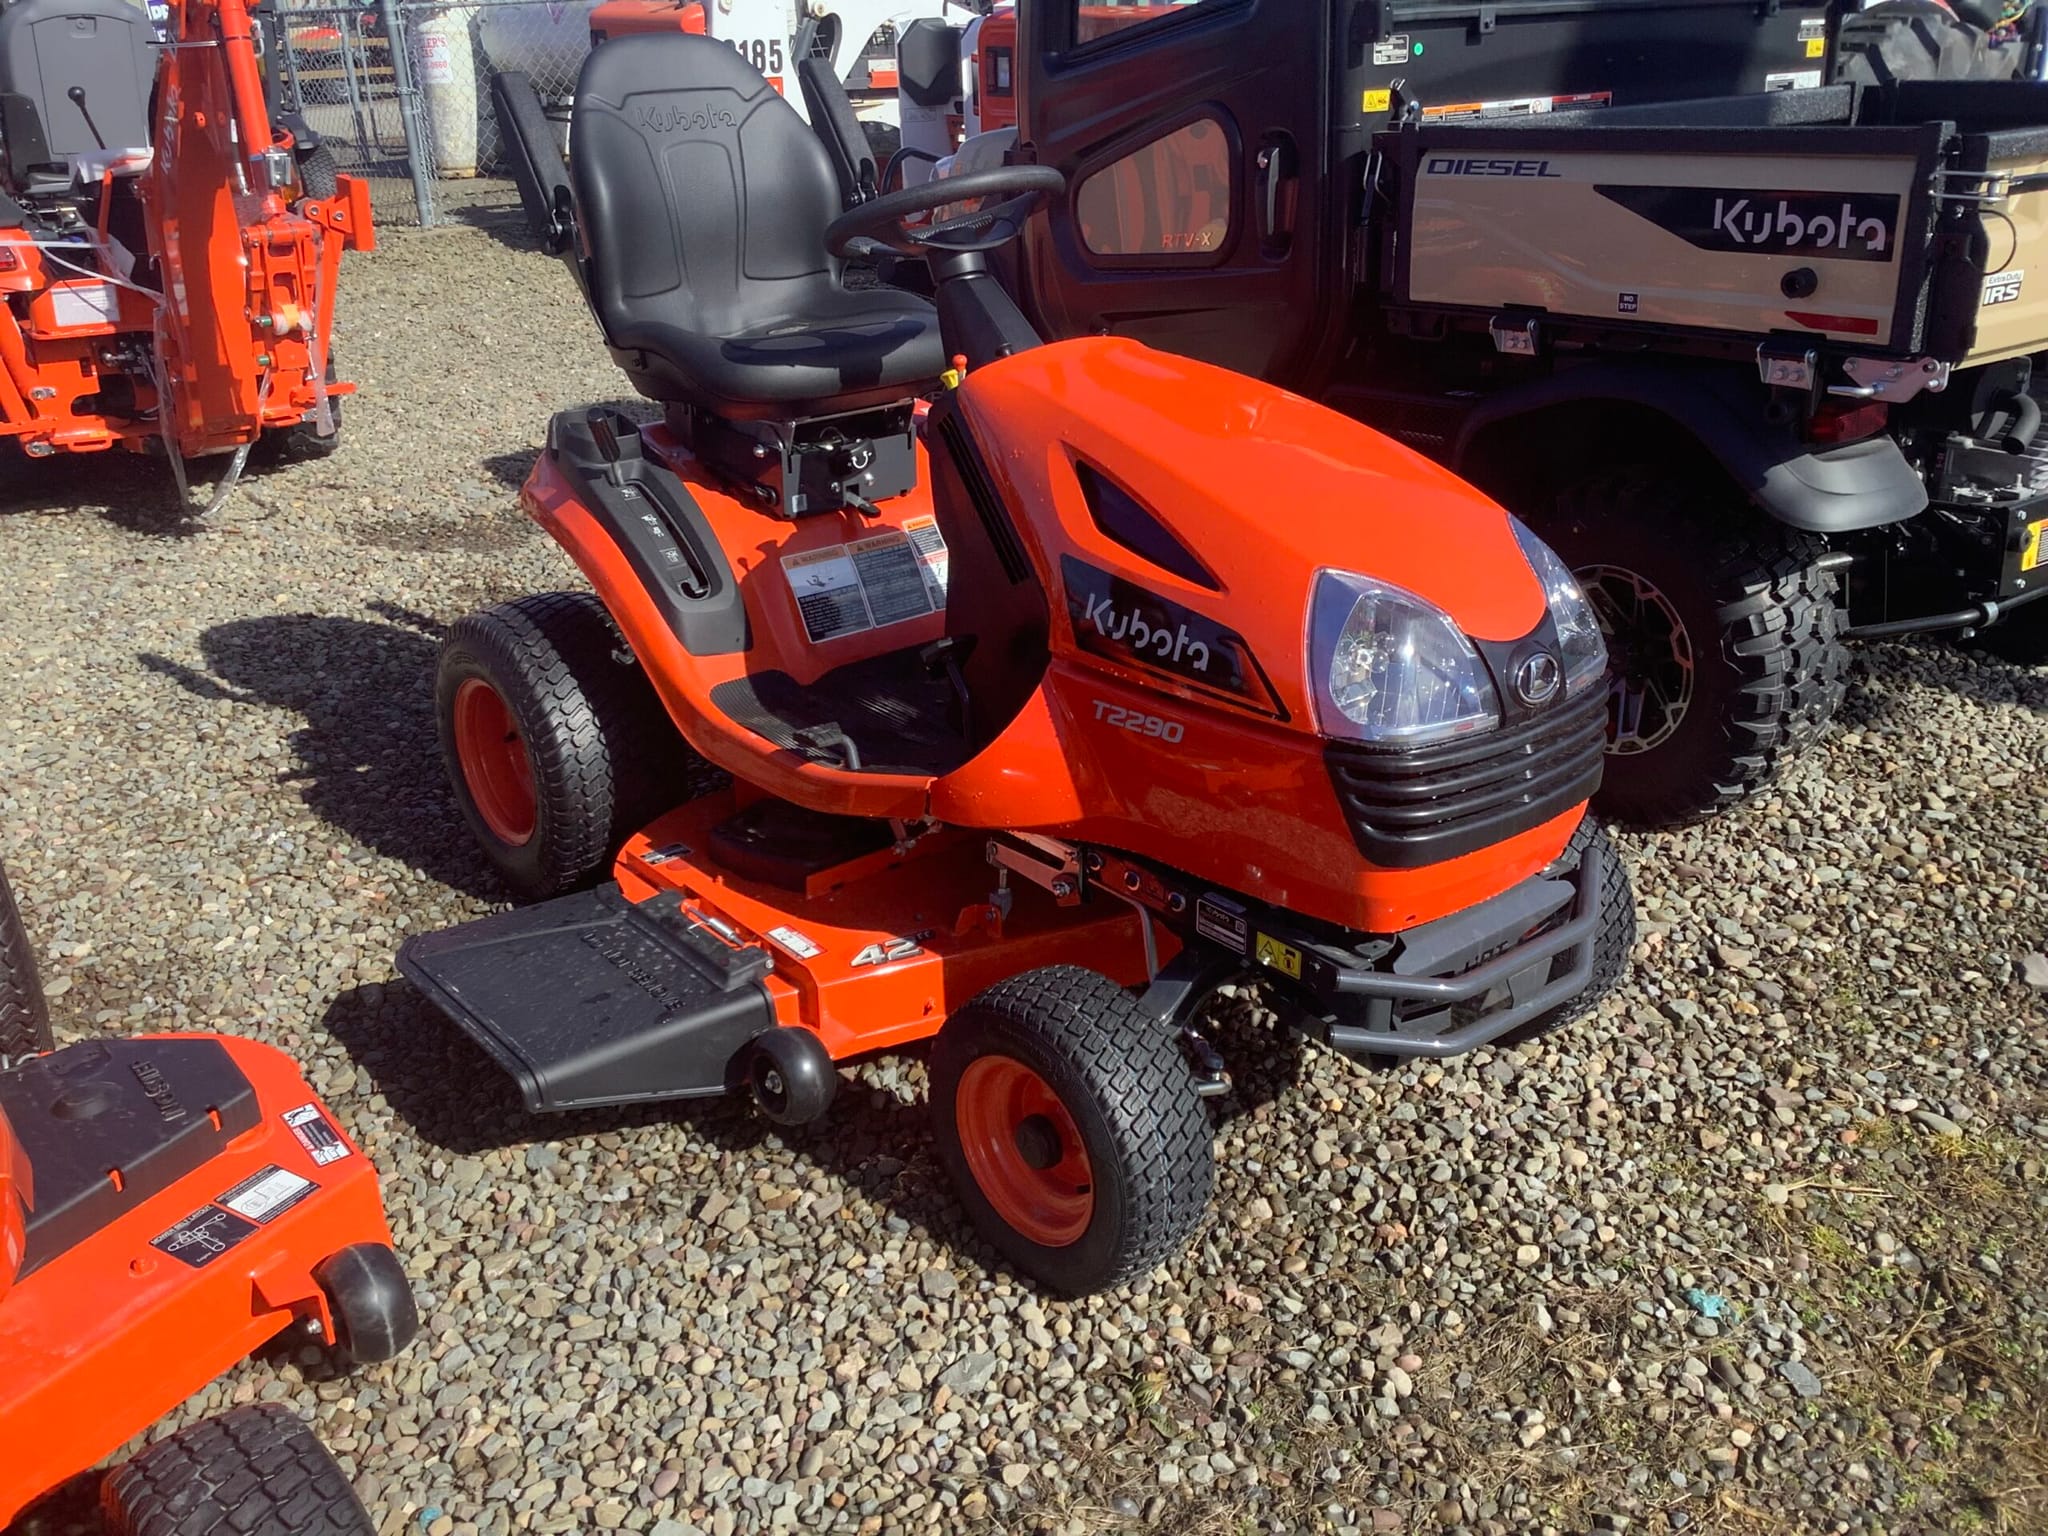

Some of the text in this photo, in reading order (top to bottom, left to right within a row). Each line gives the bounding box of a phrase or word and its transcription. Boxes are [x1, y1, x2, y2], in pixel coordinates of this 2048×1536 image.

[723, 39, 784, 74] 185
[637, 103, 738, 133] Kubota
[1426, 158, 1562, 178] DIESEL
[1161, 231, 1213, 248] RTV-X
[1713, 197, 1889, 252] Kubota
[1983, 282, 2021, 305] IRS
[1084, 592, 1211, 673] Kubota
[1091, 699, 1185, 744] T2290
